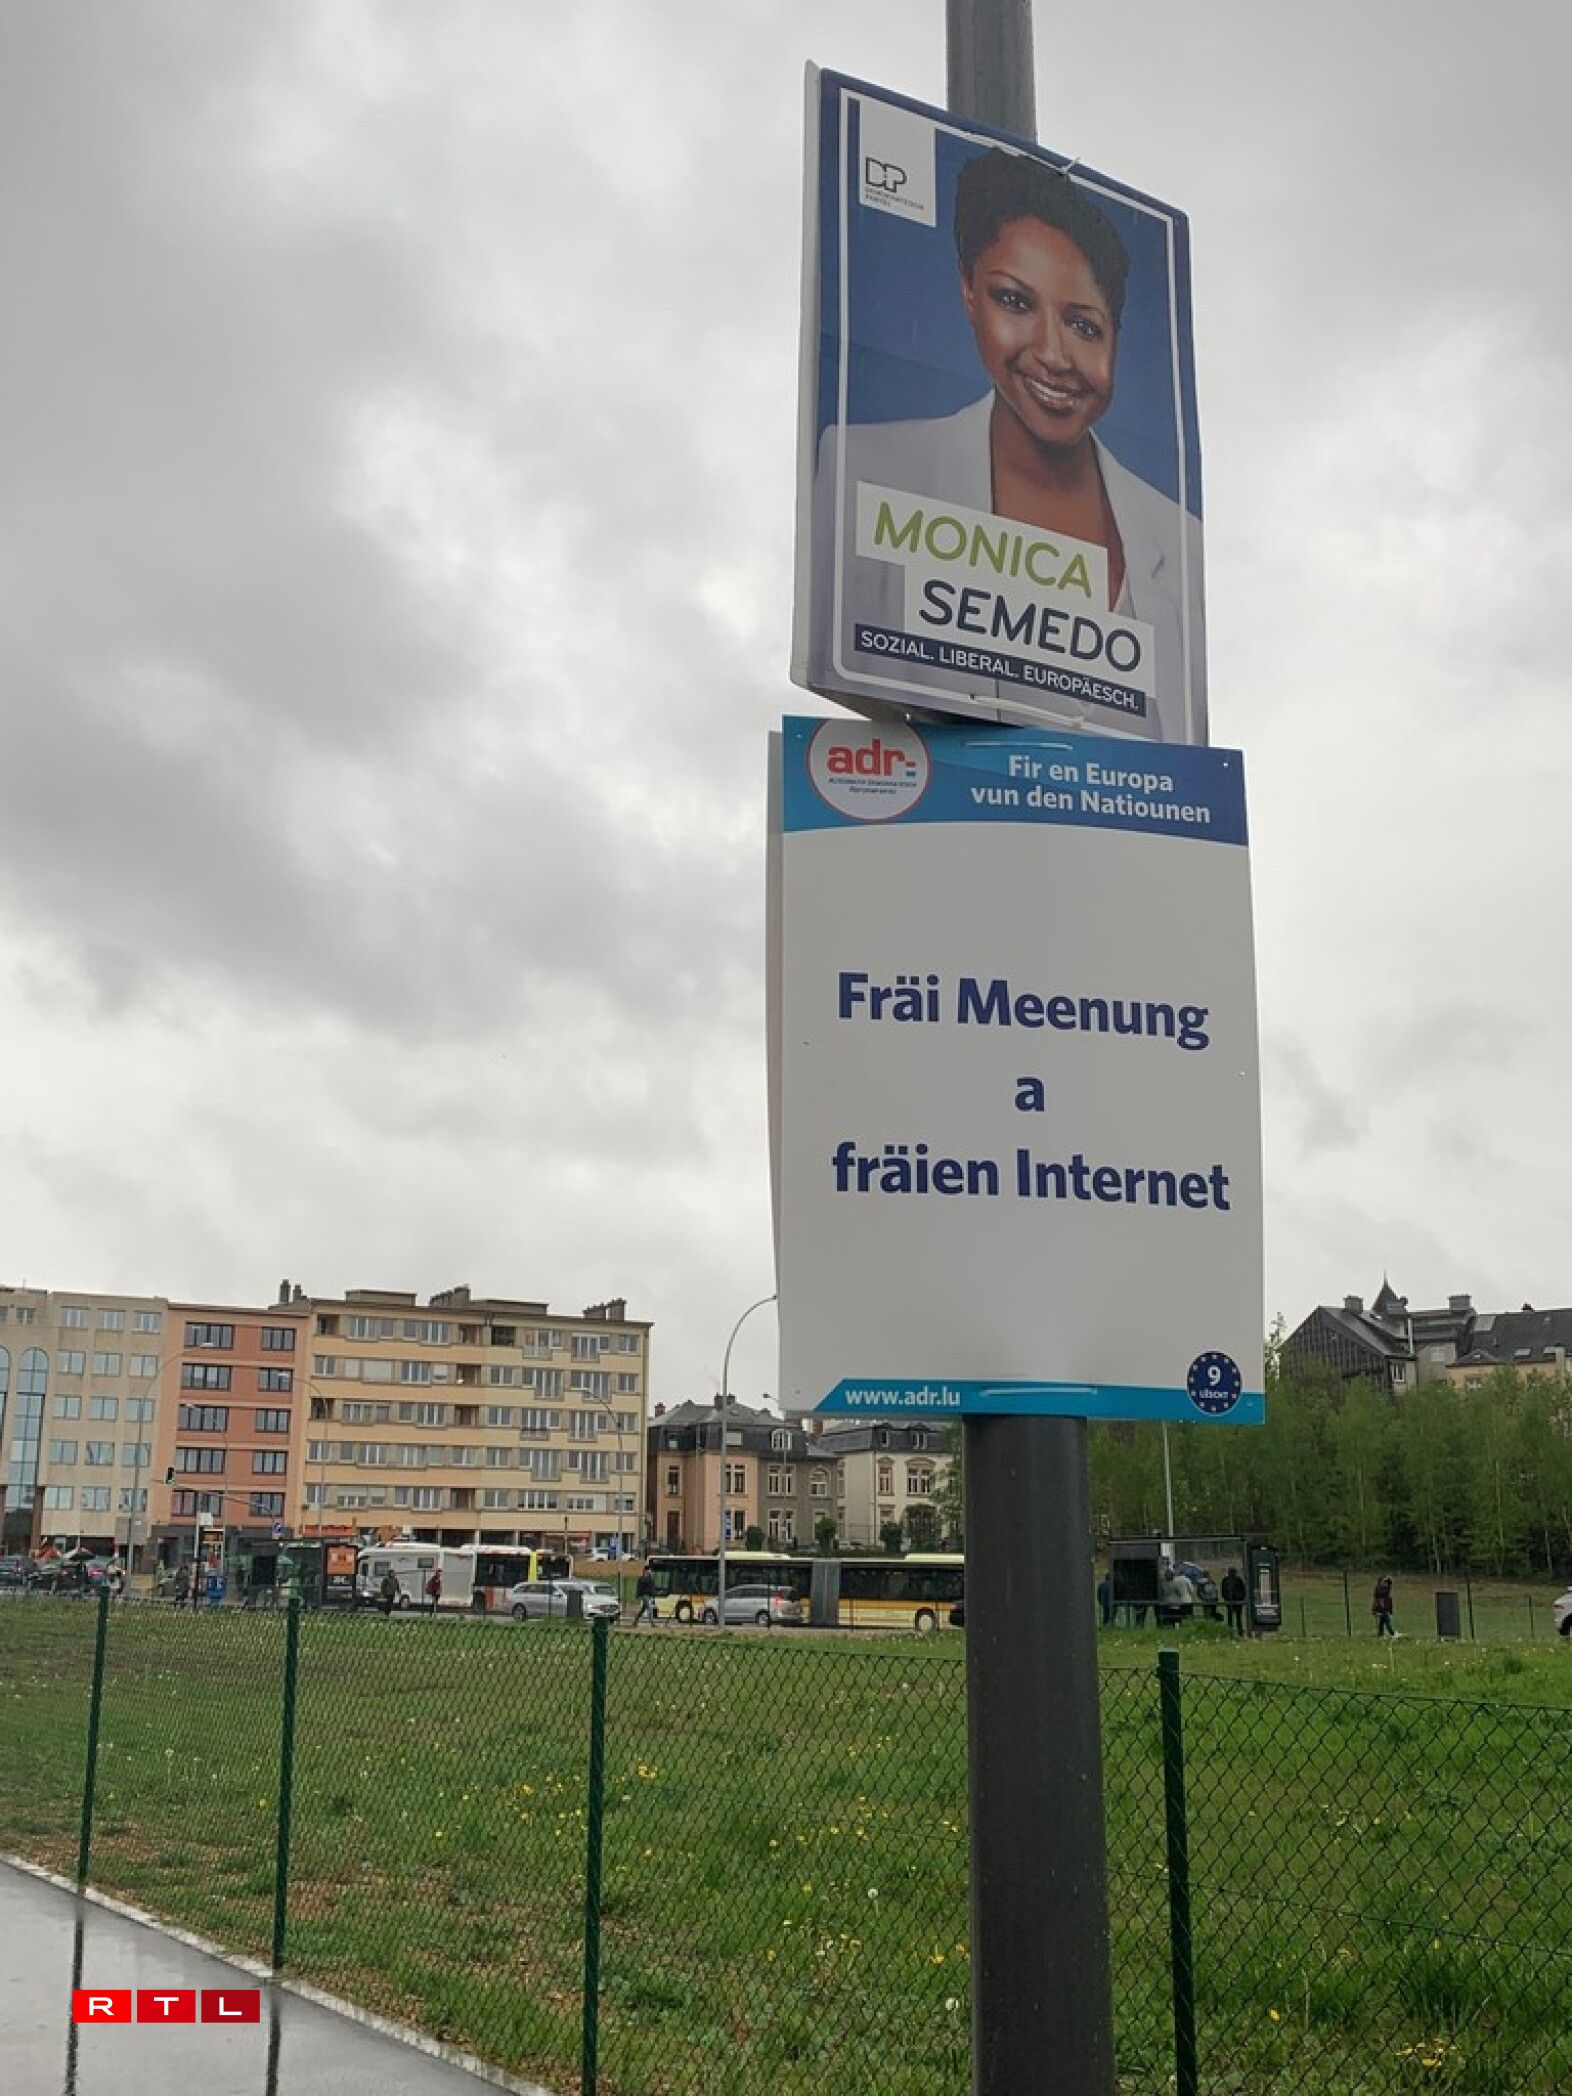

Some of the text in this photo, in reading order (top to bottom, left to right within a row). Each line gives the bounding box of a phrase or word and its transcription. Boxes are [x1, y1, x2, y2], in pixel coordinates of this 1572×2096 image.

[866, 157, 907, 193] DP
[873, 500, 1092, 598] MONICA
[918, 579, 1141, 672] SEMEDO
[861, 630, 1139, 710] SOZIAL. LIBERAL. EUROPÄESCH.
[1008, 753, 1174, 792] Fir en Europa
[971, 780, 1211, 824] vun den Natiounen
[838, 971, 1210, 1051] Fräi Meenung
[1014, 1076, 1046, 1112] a
[832, 1141, 1231, 1211] fräien Internet
[845, 1387, 961, 1408] www.adr.lu
[1207, 1365, 1221, 1386] 9
